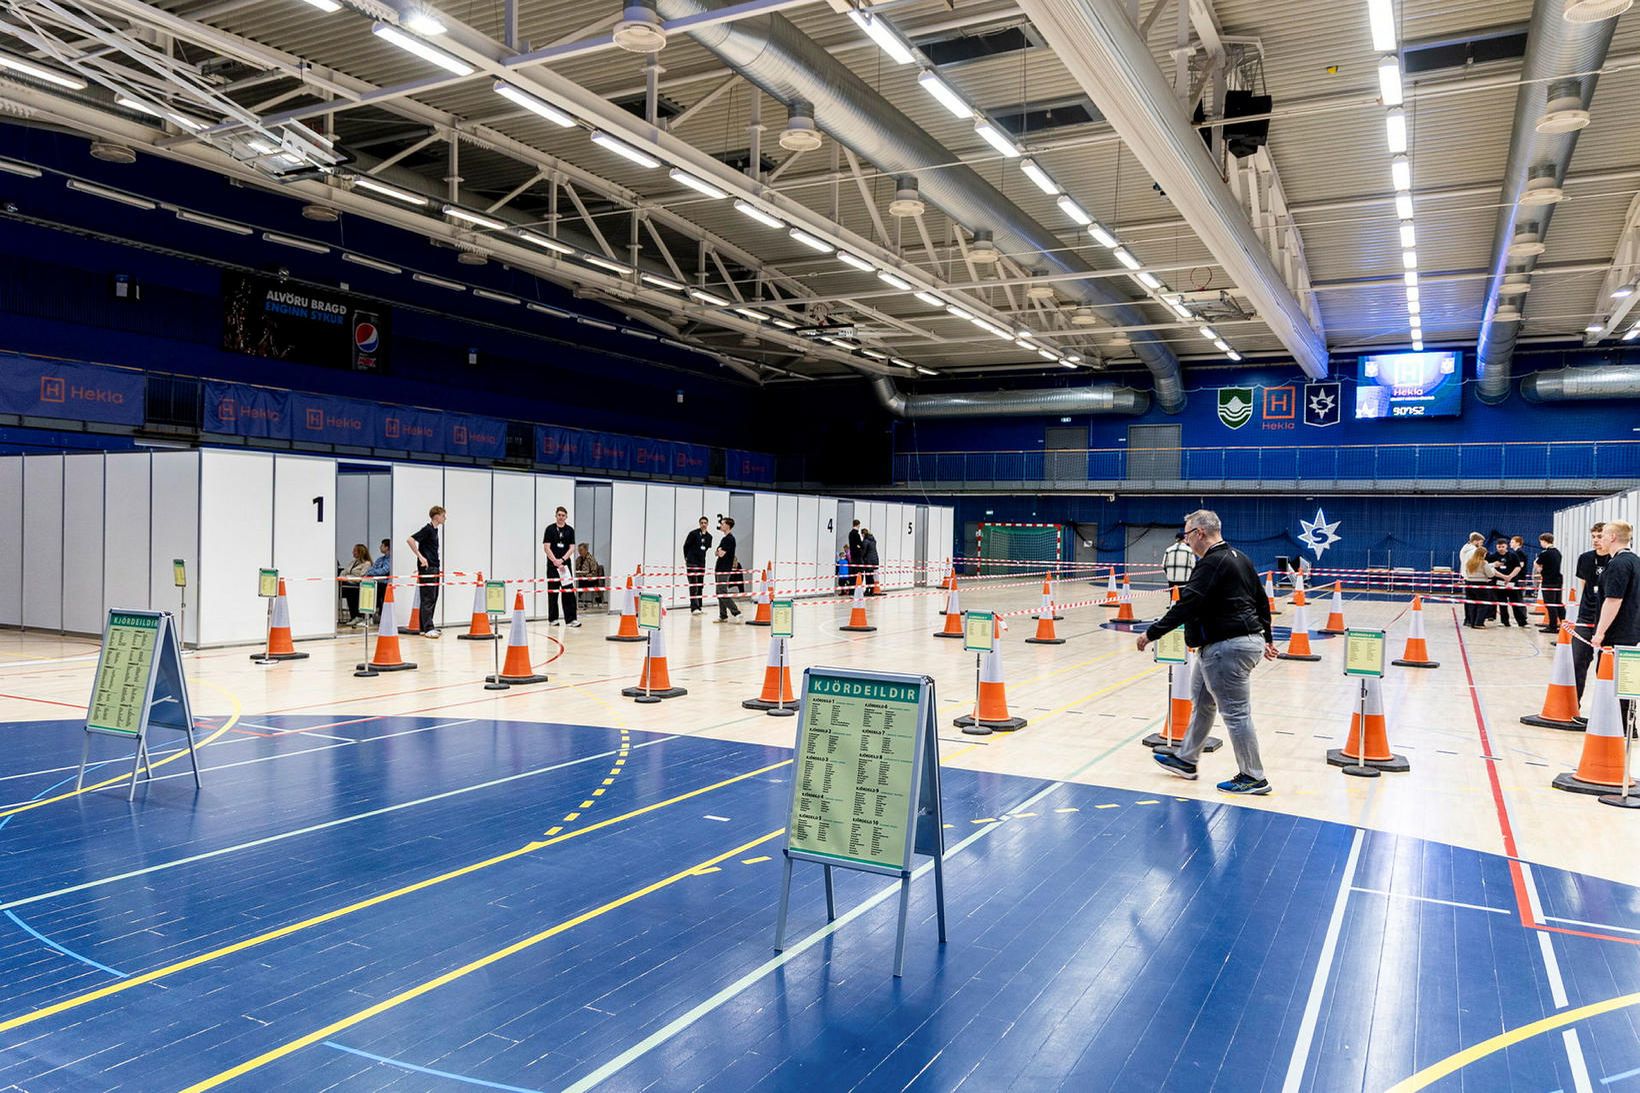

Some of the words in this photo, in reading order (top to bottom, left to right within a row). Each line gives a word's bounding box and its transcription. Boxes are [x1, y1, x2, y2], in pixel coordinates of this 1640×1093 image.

[266, 290, 308, 307] ALVÖRU
[265, 301, 308, 318] ENGINN
[311, 311, 344, 325] SYKUR
[71, 385, 124, 404] Hekla
[1262, 422, 1295, 430] Hekla
[313, 496, 323, 522] 1
[827, 518, 833, 533] 4
[907, 522, 912, 534] 5
[814, 679, 916, 700] KJÖRDEILDIR
